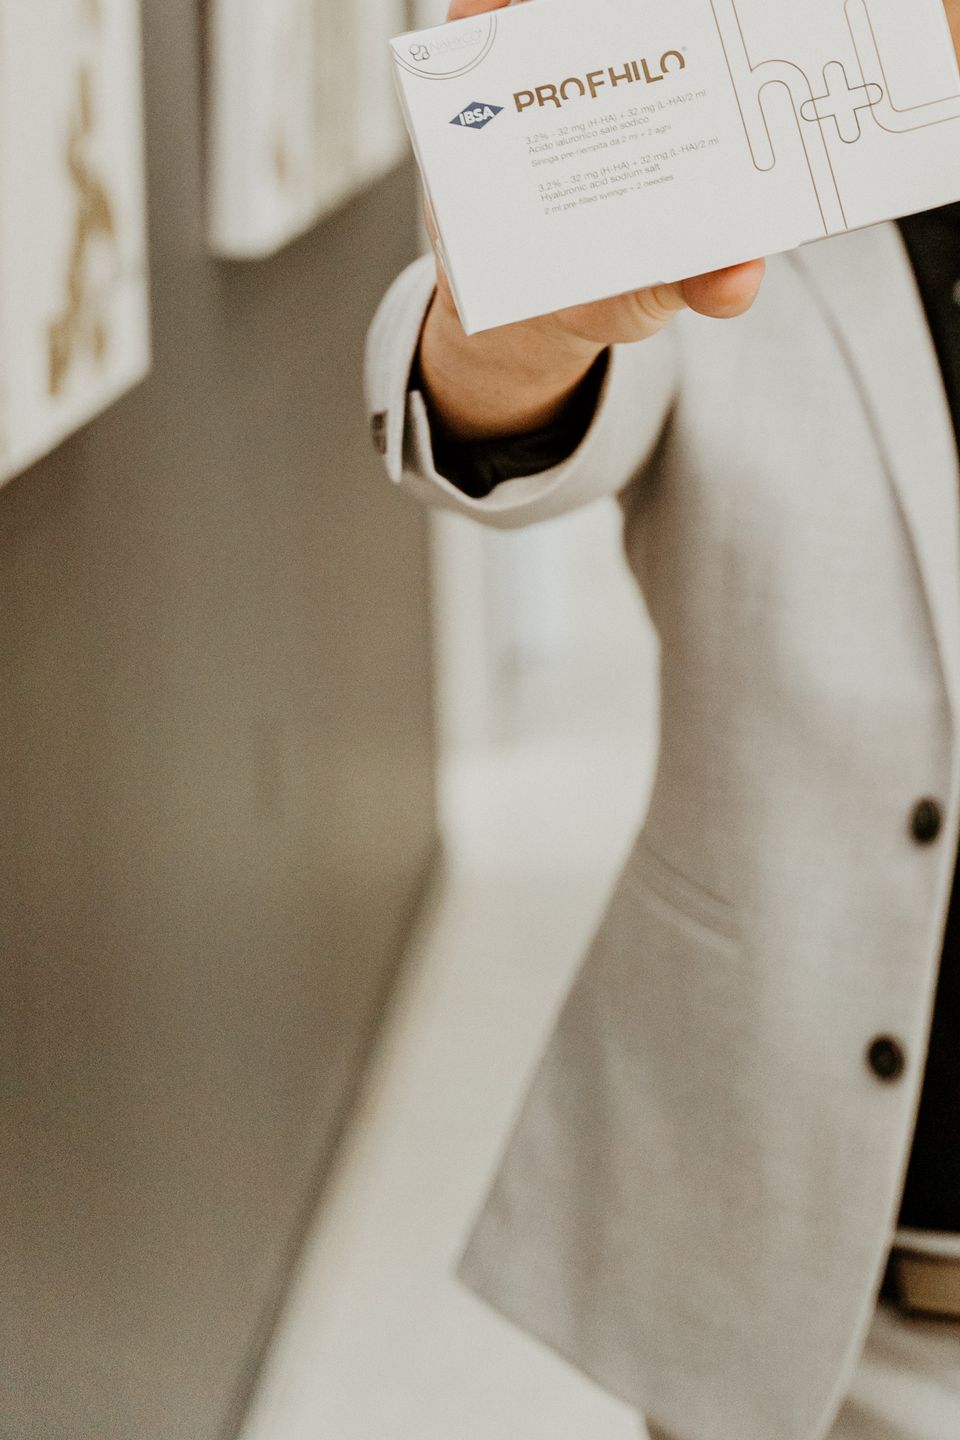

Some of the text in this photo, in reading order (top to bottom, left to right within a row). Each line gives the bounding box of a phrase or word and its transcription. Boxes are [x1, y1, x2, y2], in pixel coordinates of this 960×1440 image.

[458, 106, 494, 126] IBSA
[558, 126, 570, 136] 32
[572, 123, 586, 133] mg
[627, 107, 639, 117] 32
[641, 104, 656, 115] mg
[570, 174, 582, 184] 32
[585, 171, 599, 181] mg
[640, 154, 652, 164] 32
[654, 152, 669, 162] mg
